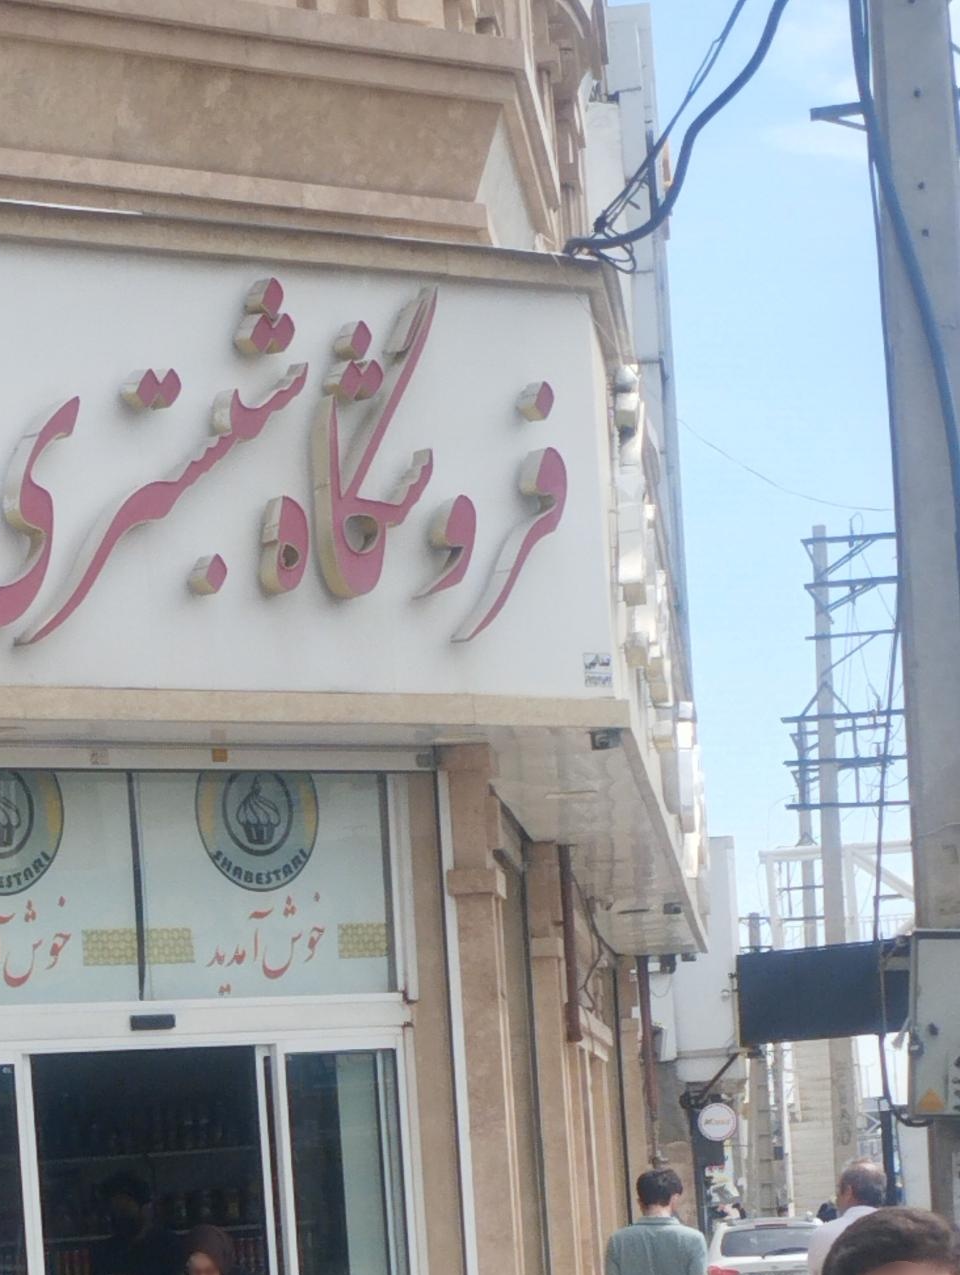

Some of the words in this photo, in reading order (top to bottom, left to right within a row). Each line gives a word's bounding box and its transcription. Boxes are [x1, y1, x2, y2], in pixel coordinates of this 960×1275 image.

[259, 284, 568, 643] فروشگاه
[213, 848, 309, 885] SHABESTARI
[3, 895, 72, 989] خوش
[205, 906, 274, 997] آمدید
[262, 891, 326, 980] خوش
